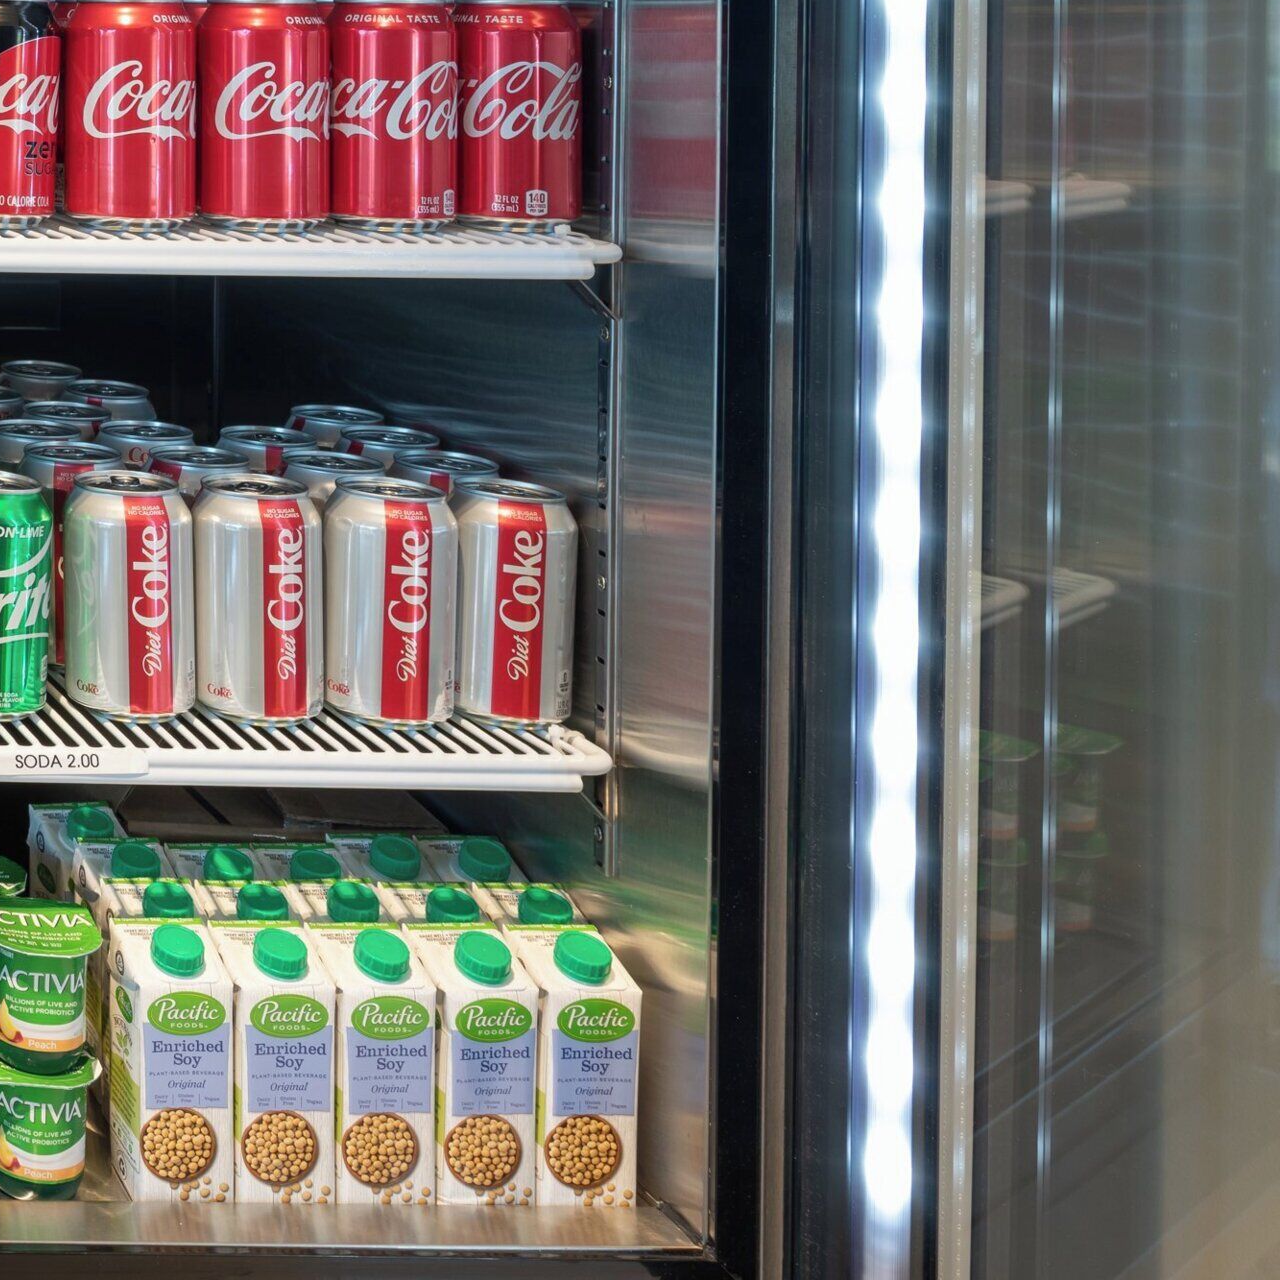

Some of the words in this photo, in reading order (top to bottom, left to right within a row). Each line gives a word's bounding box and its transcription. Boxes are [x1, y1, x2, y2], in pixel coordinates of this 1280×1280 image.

[345, 13, 403, 24] ORIGINAL
[406, 13, 440, 24] TASTE
[131, 525, 169, 627] Coke
[267, 528, 305, 631] Coke
[388, 530, 431, 633] Coke
[143, 631, 162, 679] Diet
[278, 633, 297, 681] Diet
[395, 634, 419, 683] Diet
[14, 753, 58, 769] SODA
[66, 753, 100, 768] 2.00
[0, 967, 84, 995] ACTIVIA
[155, 998, 220, 1022] Pacific
[258, 1000, 322, 1025] Pacific
[360, 1002, 424, 1028] Pacific
[28, 1038, 58, 1051] Peach
[152, 1040, 224, 1053] Enriched
[254, 1043, 327, 1056] Enriched
[356, 1044, 428, 1058] Enriched
[173, 1053, 201, 1068] Soy
[167, 1079, 206, 1090] Original
